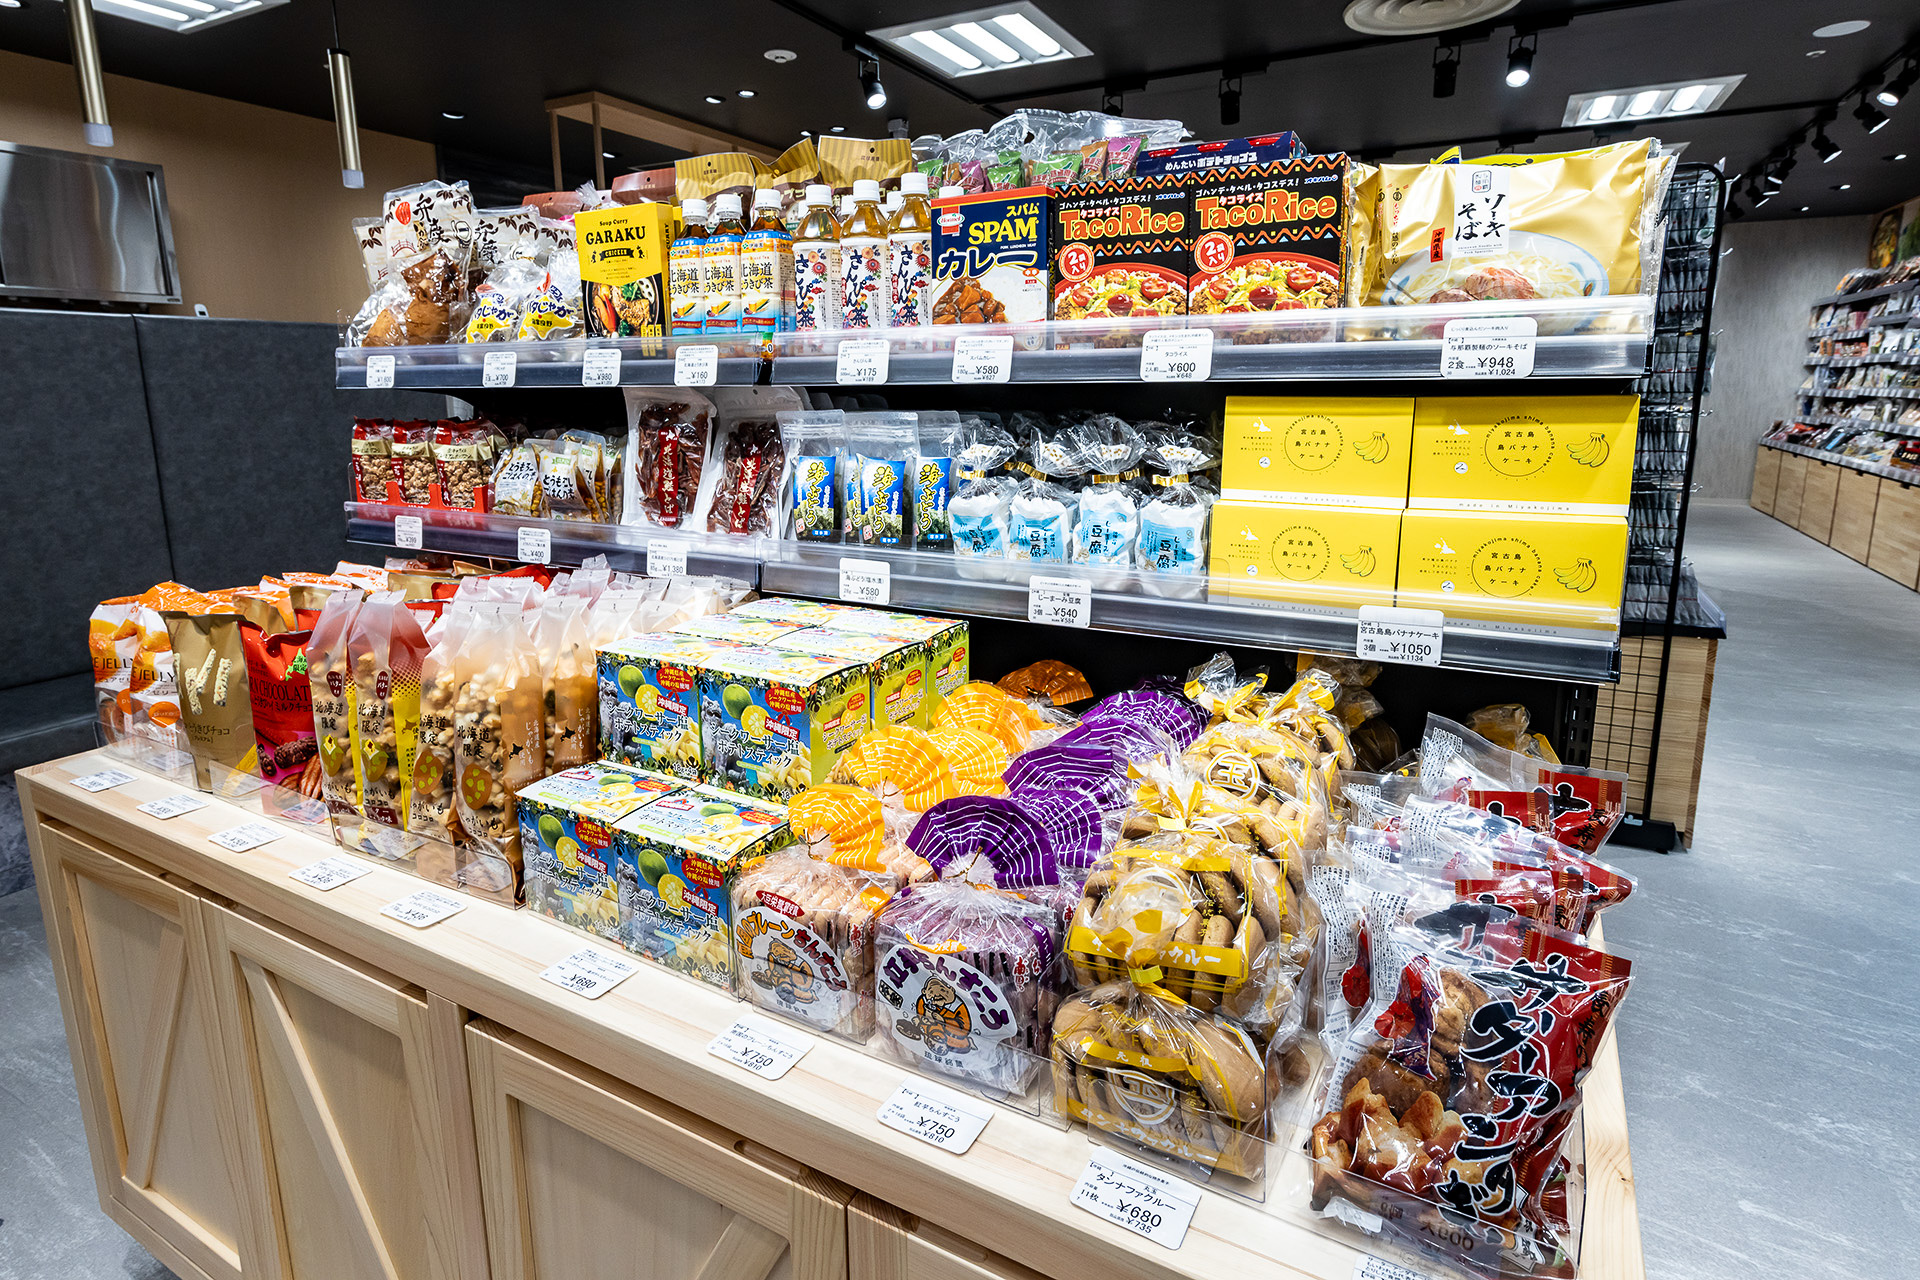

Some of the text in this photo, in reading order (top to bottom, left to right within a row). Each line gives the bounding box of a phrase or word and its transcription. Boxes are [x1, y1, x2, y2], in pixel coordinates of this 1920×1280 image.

[1219, 192, 1264, 206] タコライス
[1006, 203, 1039, 217] スパム
[1080, 207, 1120, 219] タコライス
[1195, 189, 1338, 230] TacoRice
[1483, 194, 1506, 238] ソーキ
[1059, 204, 1185, 240] TacoRice
[1455, 203, 1483, 241] そば
[586, 226, 646, 246] GARAKU
[968, 217, 1038, 245] SPAM
[1433, 232, 1442, 259] 沖縄県産
[936, 247, 1038, 281] カレー
[846, 249, 869, 327] さんぴん茶
[897, 245, 919, 324] さんぴん茶
[976, 366, 999, 375] ¥580
[1168, 362, 1196, 373] ¥600
[1448, 360, 1465, 370] 2食
[1478, 357, 1514, 369] ¥948
[856, 368, 877, 377] ¥175
[1295, 440, 1331, 448] 島バナナ
[1485, 415, 1556, 467] miyakojima shima banana cake
[806, 461, 829, 528] 海ぶどう
[873, 466, 898, 534] 海ぶどう
[919, 462, 944, 530] 海ぶどう
[1508, 504, 1570, 512] Miyakojima
[1030, 531, 1041, 557] 豆腐
[1089, 525, 1103, 554] 豆腐
[1157, 540, 1171, 569] 豆腐
[1283, 551, 1317, 559] 島バナナ
[1491, 552, 1522, 561] 宮古島
[1472, 537, 1543, 590] miyakojima shima banana cake
[1484, 564, 1527, 574] 島バナナ
[1489, 578, 1519, 586] ケーキ
[860, 587, 880, 597] ¥580
[1039, 594, 1081, 605] じーまーみ豆腐
[1053, 607, 1078, 619] ¥540
[1360, 626, 1440, 640] 宮古島島バナナケーキ
[1364, 644, 1376, 652] 3個
[1390, 642, 1432, 656] ¥1050
[1400, 654, 1423, 662] ¥1134
[138, 669, 177, 683] JELLY
[660, 673, 690, 683] シークワーサー
[665, 668, 685, 677] 沖縄県産
[768, 694, 803, 706] シークワーサー
[774, 688, 796, 699] 沖縄県産
[315, 701, 344, 717] 北海道
[358, 704, 386, 720] 北海道
[658, 696, 687, 715] 沖縄限定
[322, 716, 337, 731] 限定
[420, 715, 447, 732] 海道
[608, 703, 689, 731] シークワーサー塩
[361, 720, 380, 735] 限定
[458, 726, 491, 744] 北海道
[614, 718, 683, 742] ポテトスティック
[765, 718, 798, 740] 沖縄限定
[711, 722, 800, 757] シークワーサー塩
[462, 744, 485, 759] 限定
[718, 740, 792, 768] ポテトスティック
[412, 813, 434, 822] コロコロ
[578, 828, 609, 842] シークワーサー
[582, 823, 602, 833] 沖縄県産
[530, 848, 609, 889] シークワーサー塩
[577, 852, 607, 874] 沖縄限定
[690, 860, 713, 872] 沖縄県産
[685, 865, 721, 879] シークワーサー
[626, 886, 720, 932] シークワーサー塩
[682, 889, 718, 915] 沖縄限定
[634, 906, 712, 943] ポテトスティック
[570, 974, 597, 989] ¥680
[742, 1046, 774, 1068] ¥750
[1116, 1051, 1153, 1068] 元祖
[744, 1060, 763, 1072] ¥810
[914, 1101, 960, 1123] 紅芋ちんすこう
[919, 1117, 956, 1139] ¥750
[924, 1130, 945, 1143] ¥810
[1081, 1189, 1099, 1203] 11枚
[1096, 1173, 1177, 1211] タンナファクルー
[1119, 1199, 1162, 1228] ¥680
[1127, 1217, 1153, 1234] ¥735
